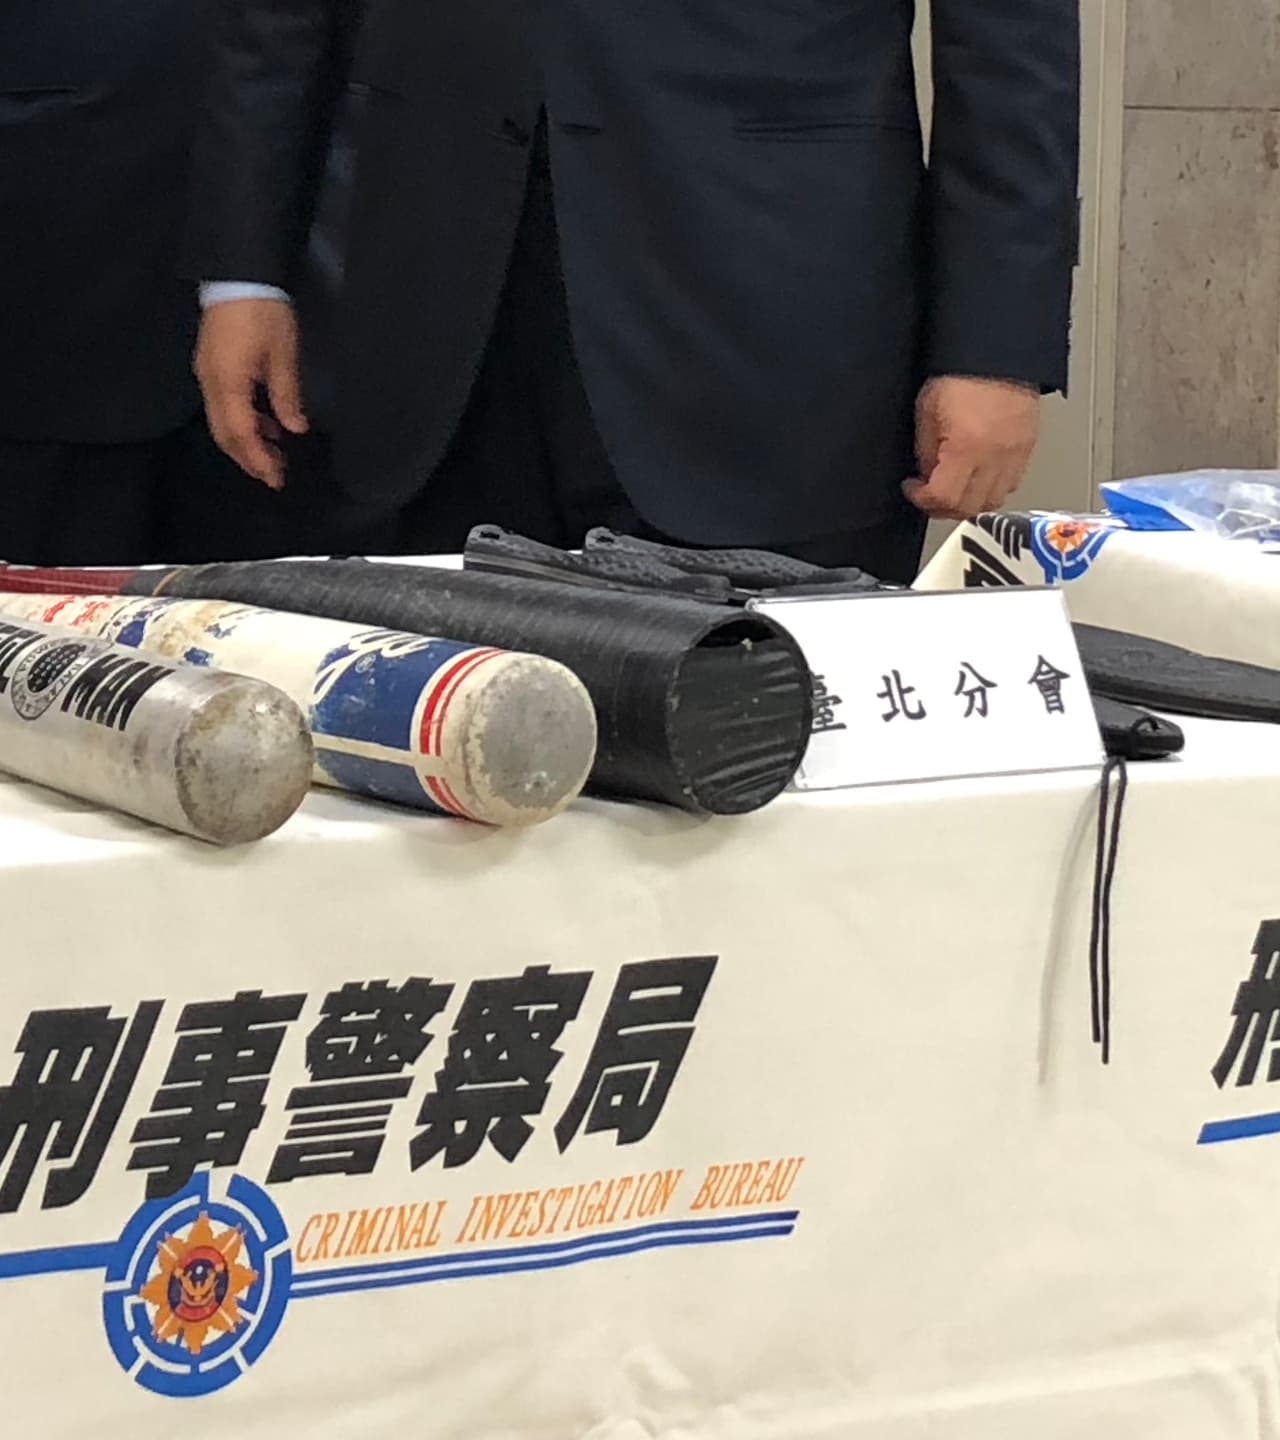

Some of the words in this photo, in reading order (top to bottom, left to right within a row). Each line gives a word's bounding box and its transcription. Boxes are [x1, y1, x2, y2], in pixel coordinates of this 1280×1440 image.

[60, 652, 176, 733] MAN
[810, 653, 1072, 735] 臺北分會
[294, 1198, 449, 1263] CRIMINAL
[456, 1168, 684, 1245] INVESTIGATION
[690, 1157, 806, 1212] BUREAU
